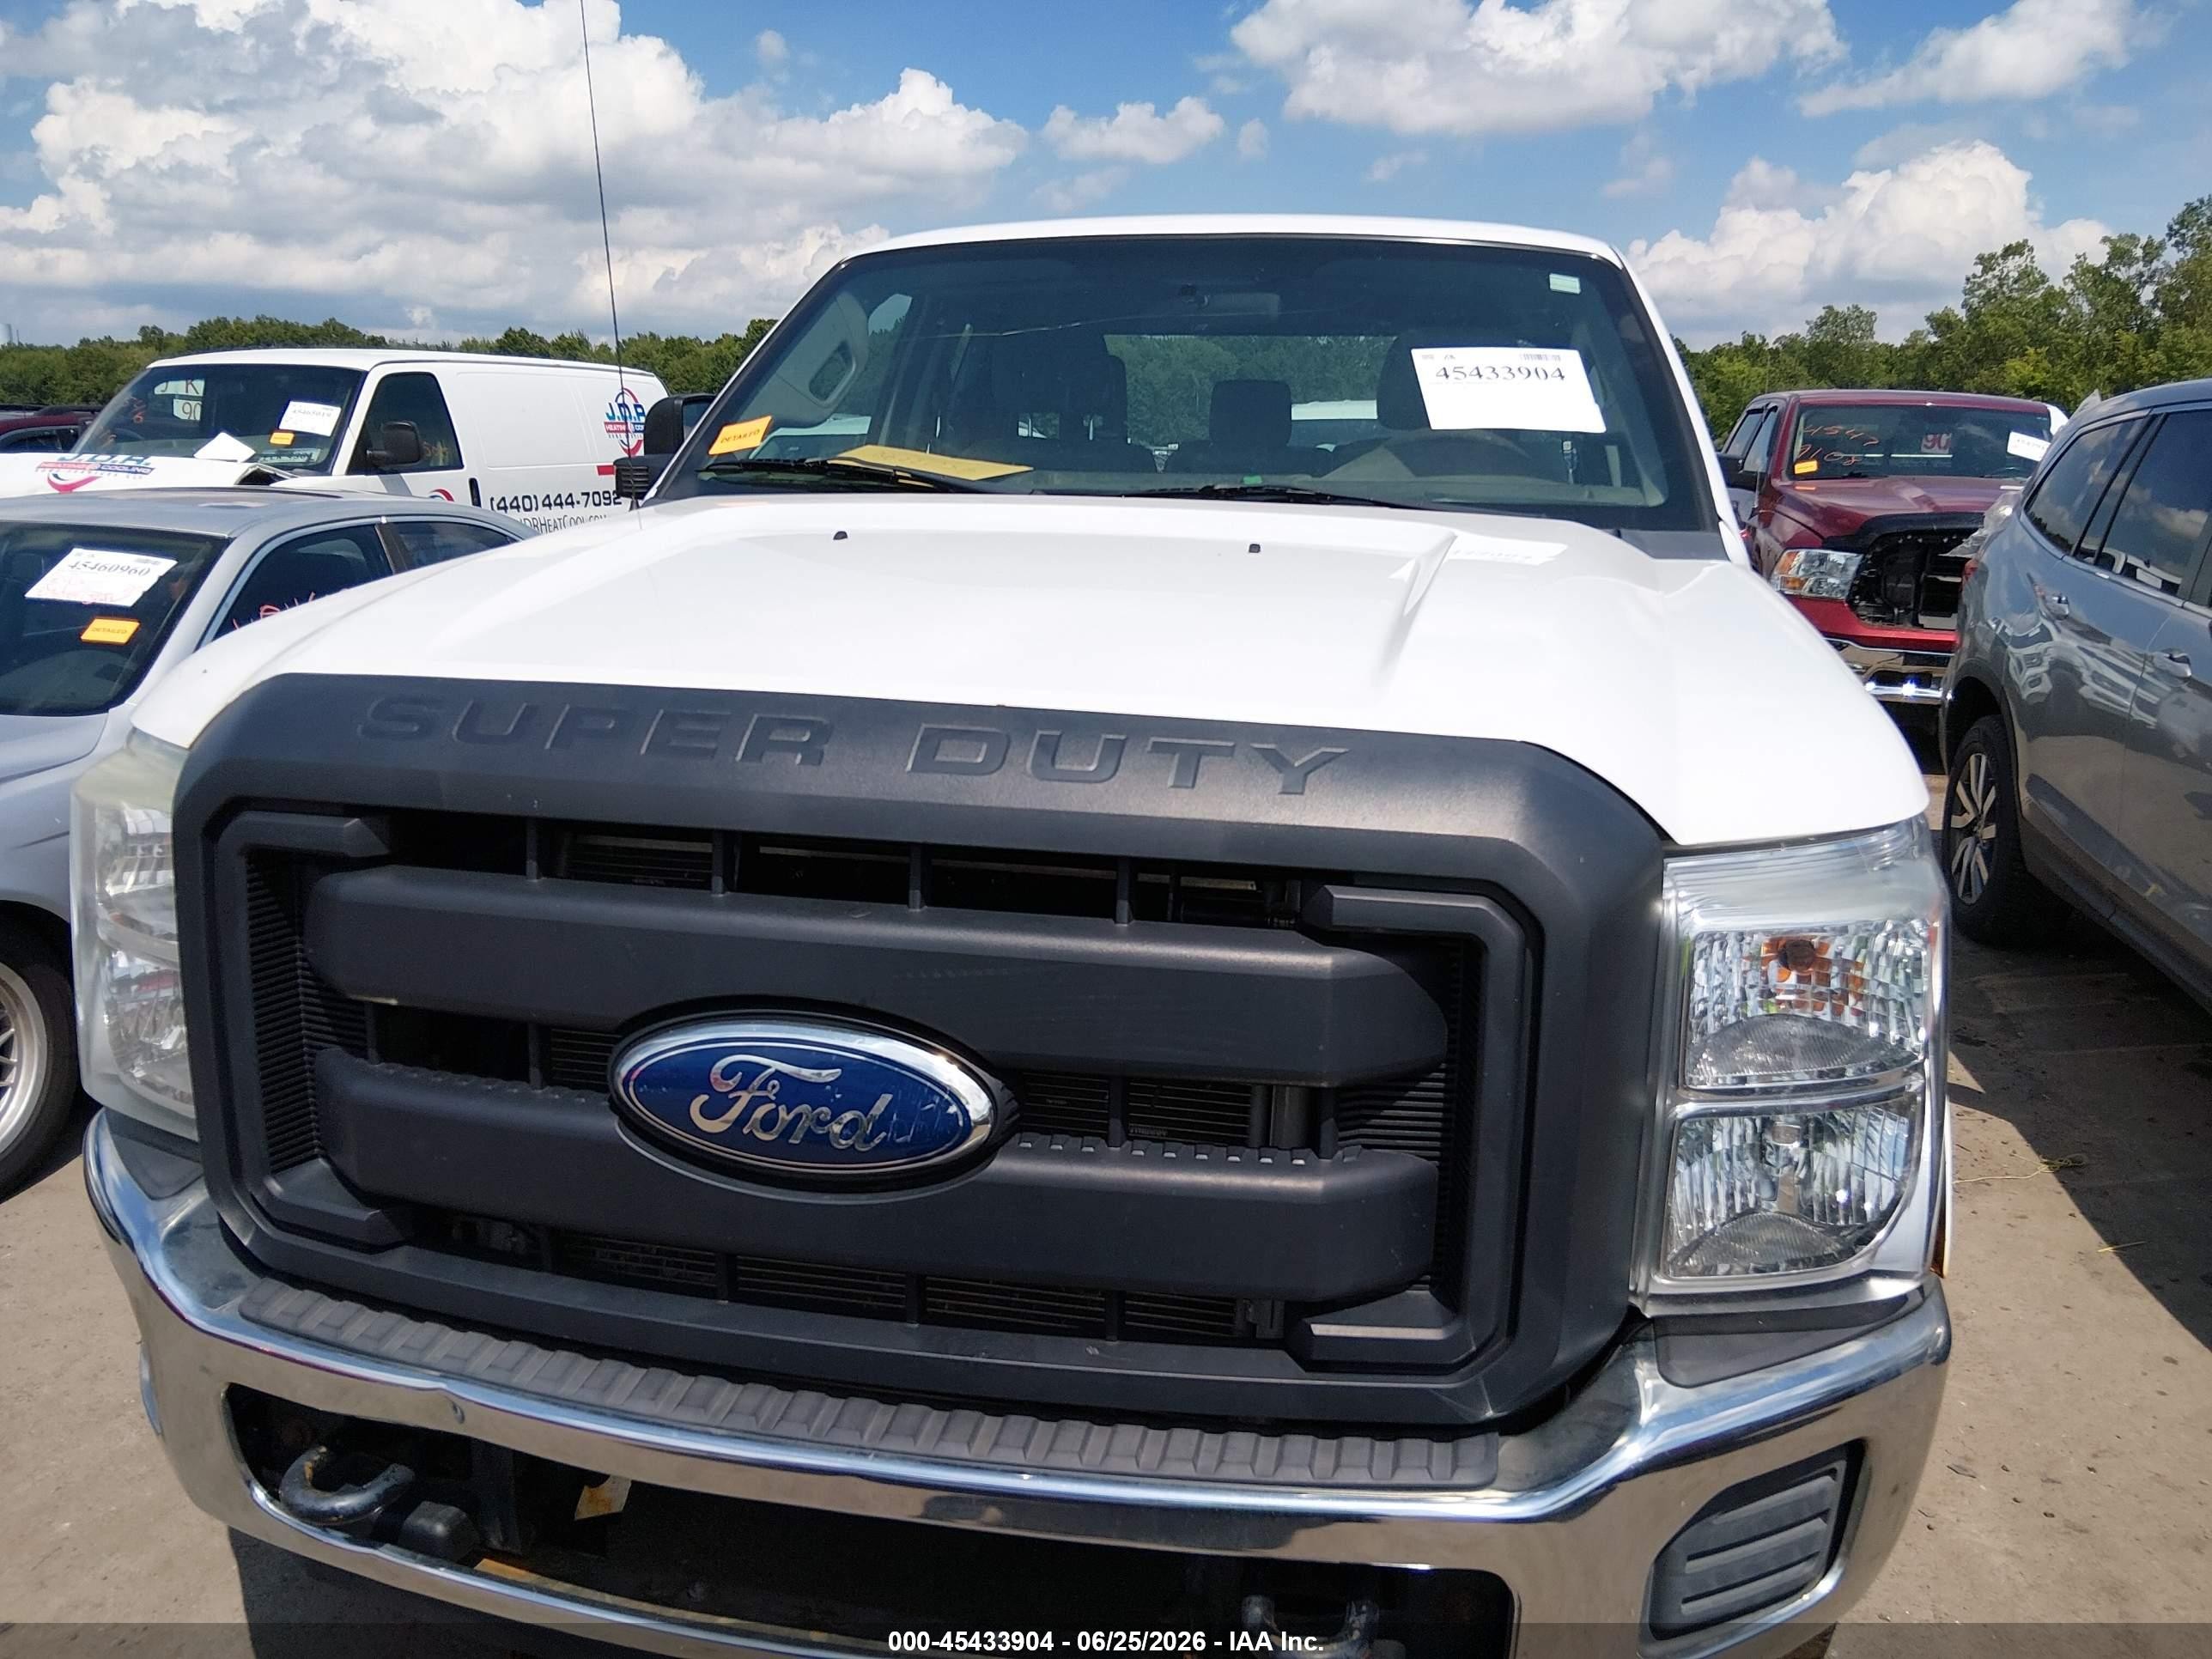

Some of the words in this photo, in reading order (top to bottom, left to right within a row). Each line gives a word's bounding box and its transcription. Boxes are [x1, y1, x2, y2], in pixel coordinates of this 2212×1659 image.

[1435, 362, 1565, 380] 45433904
[489, 495, 539, 514] (440)
[68, 560, 151, 577] 45460960
[356, 695, 835, 767] SUPER
[905, 722, 1352, 796] DUTY
[689, 1054, 894, 1152] Ford
